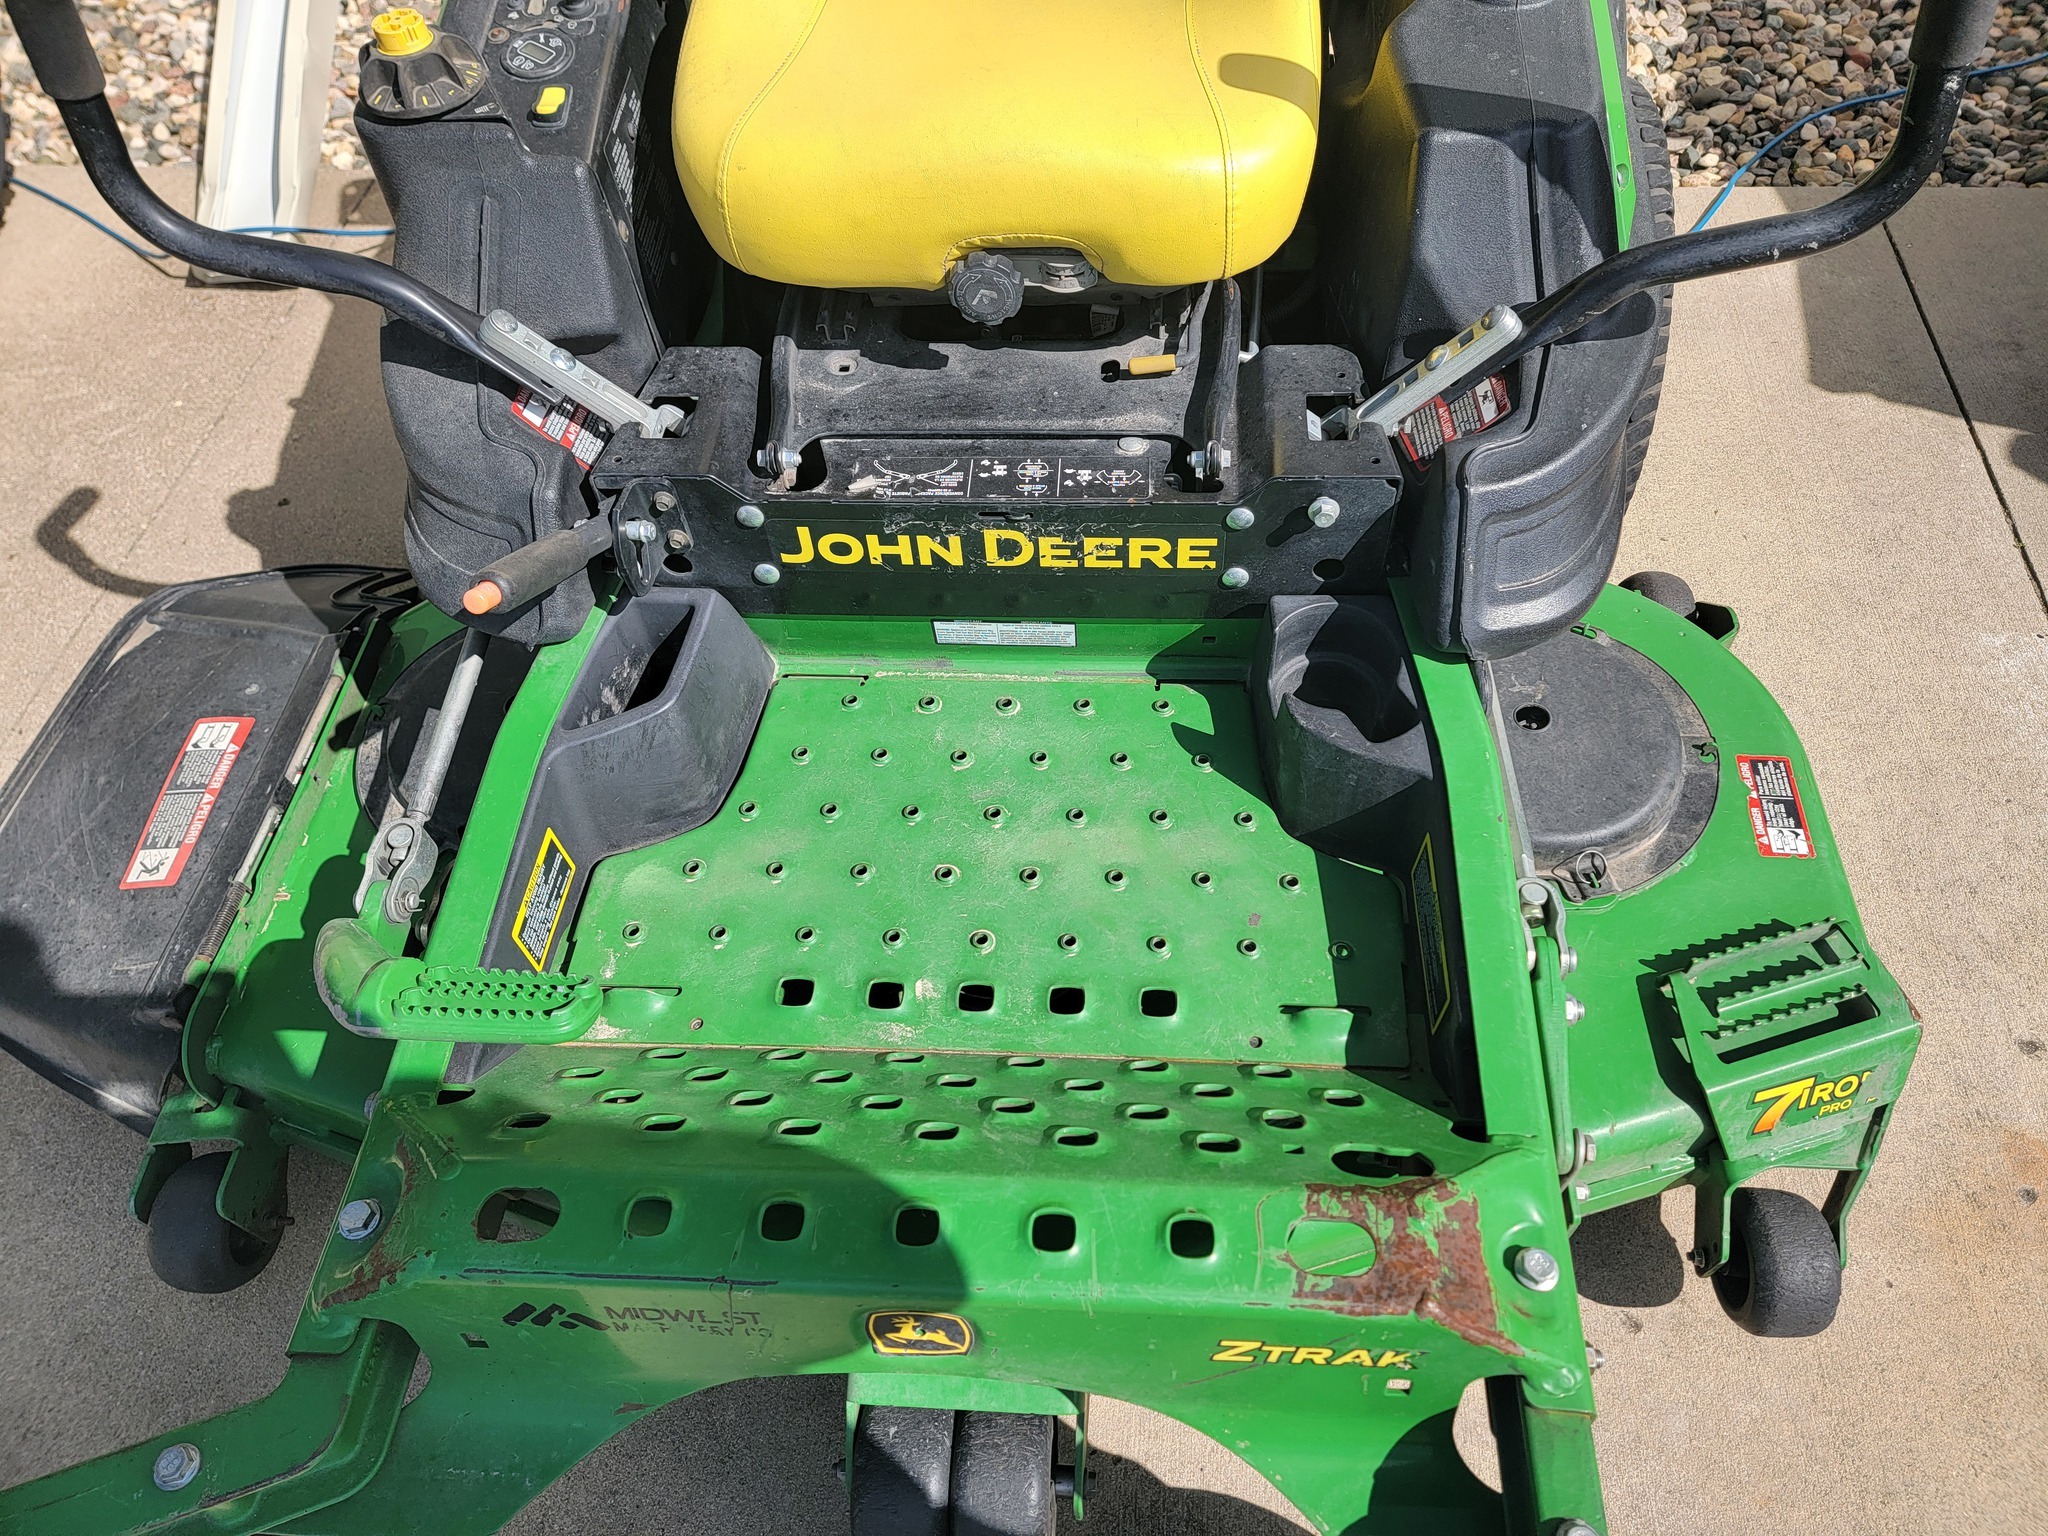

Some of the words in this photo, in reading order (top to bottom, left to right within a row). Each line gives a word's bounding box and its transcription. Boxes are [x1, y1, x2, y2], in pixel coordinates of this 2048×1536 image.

[957, 290, 978, 317] ADJUST
[1493, 379, 1508, 408] DANGER
[567, 407, 589, 441] PELIGRO
[1441, 408, 1454, 439] PELIGRO
[780, 525, 964, 567] JOHN
[983, 528, 1219, 570] DEERE
[208, 751, 236, 790] DANGER
[184, 802, 211, 844] PELIGRO
[1750, 807, 1766, 835] DANGER
[525, 863, 541, 898] CAUTION
[1818, 1099, 1853, 1117] PRO
